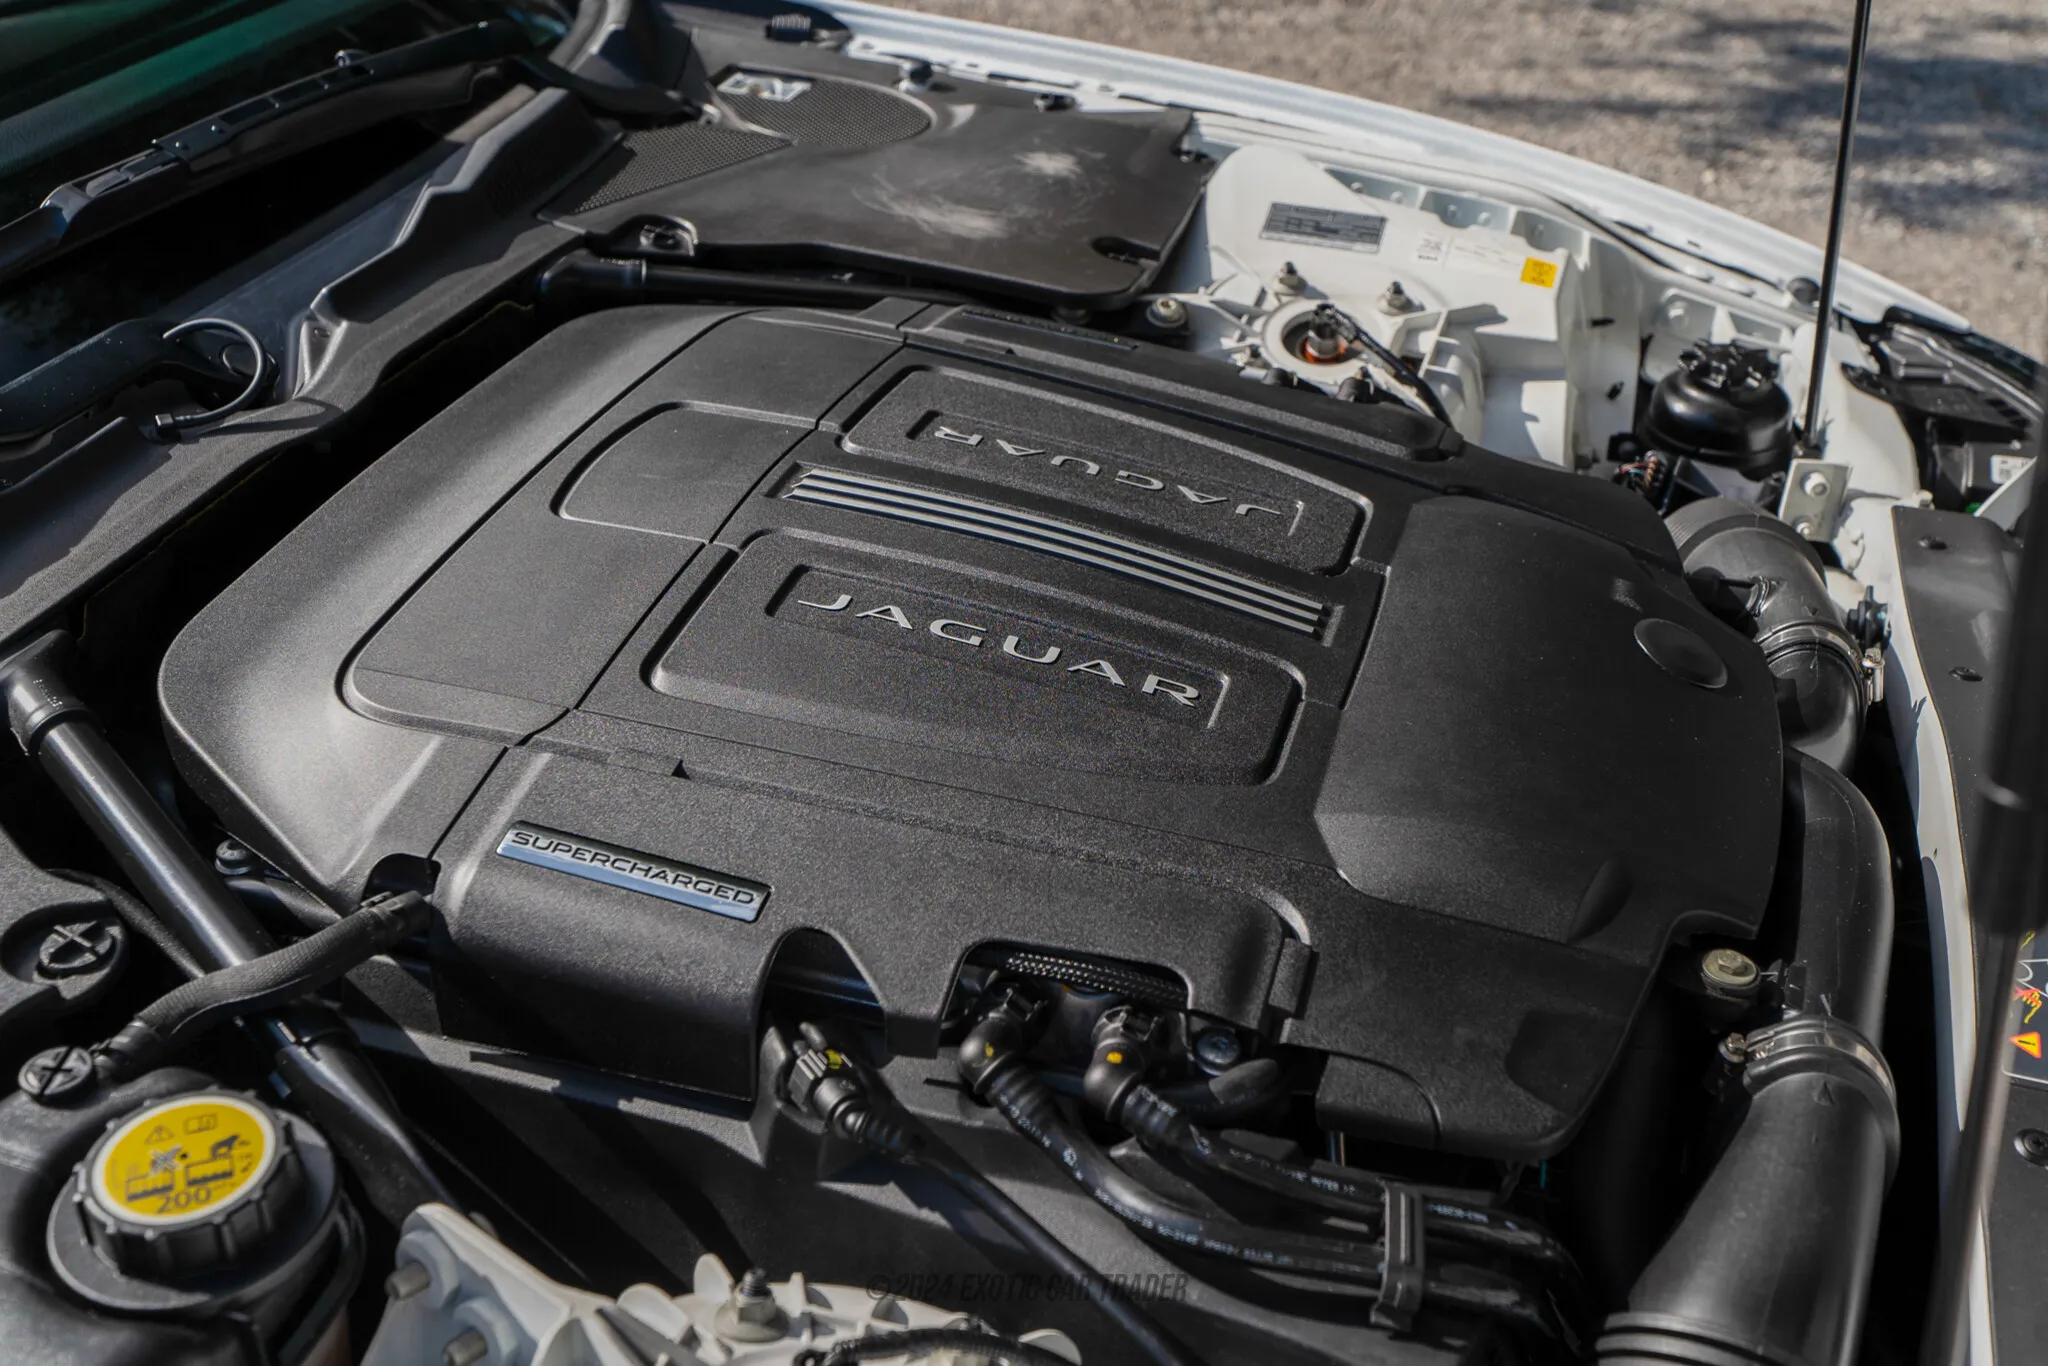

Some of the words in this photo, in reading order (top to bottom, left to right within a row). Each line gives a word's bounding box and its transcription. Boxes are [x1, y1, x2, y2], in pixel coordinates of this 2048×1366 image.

[934, 425, 1283, 517] JAGUAR
[797, 593, 1200, 708] JAGUAR
[511, 830, 756, 905] SUPERCHARGED
